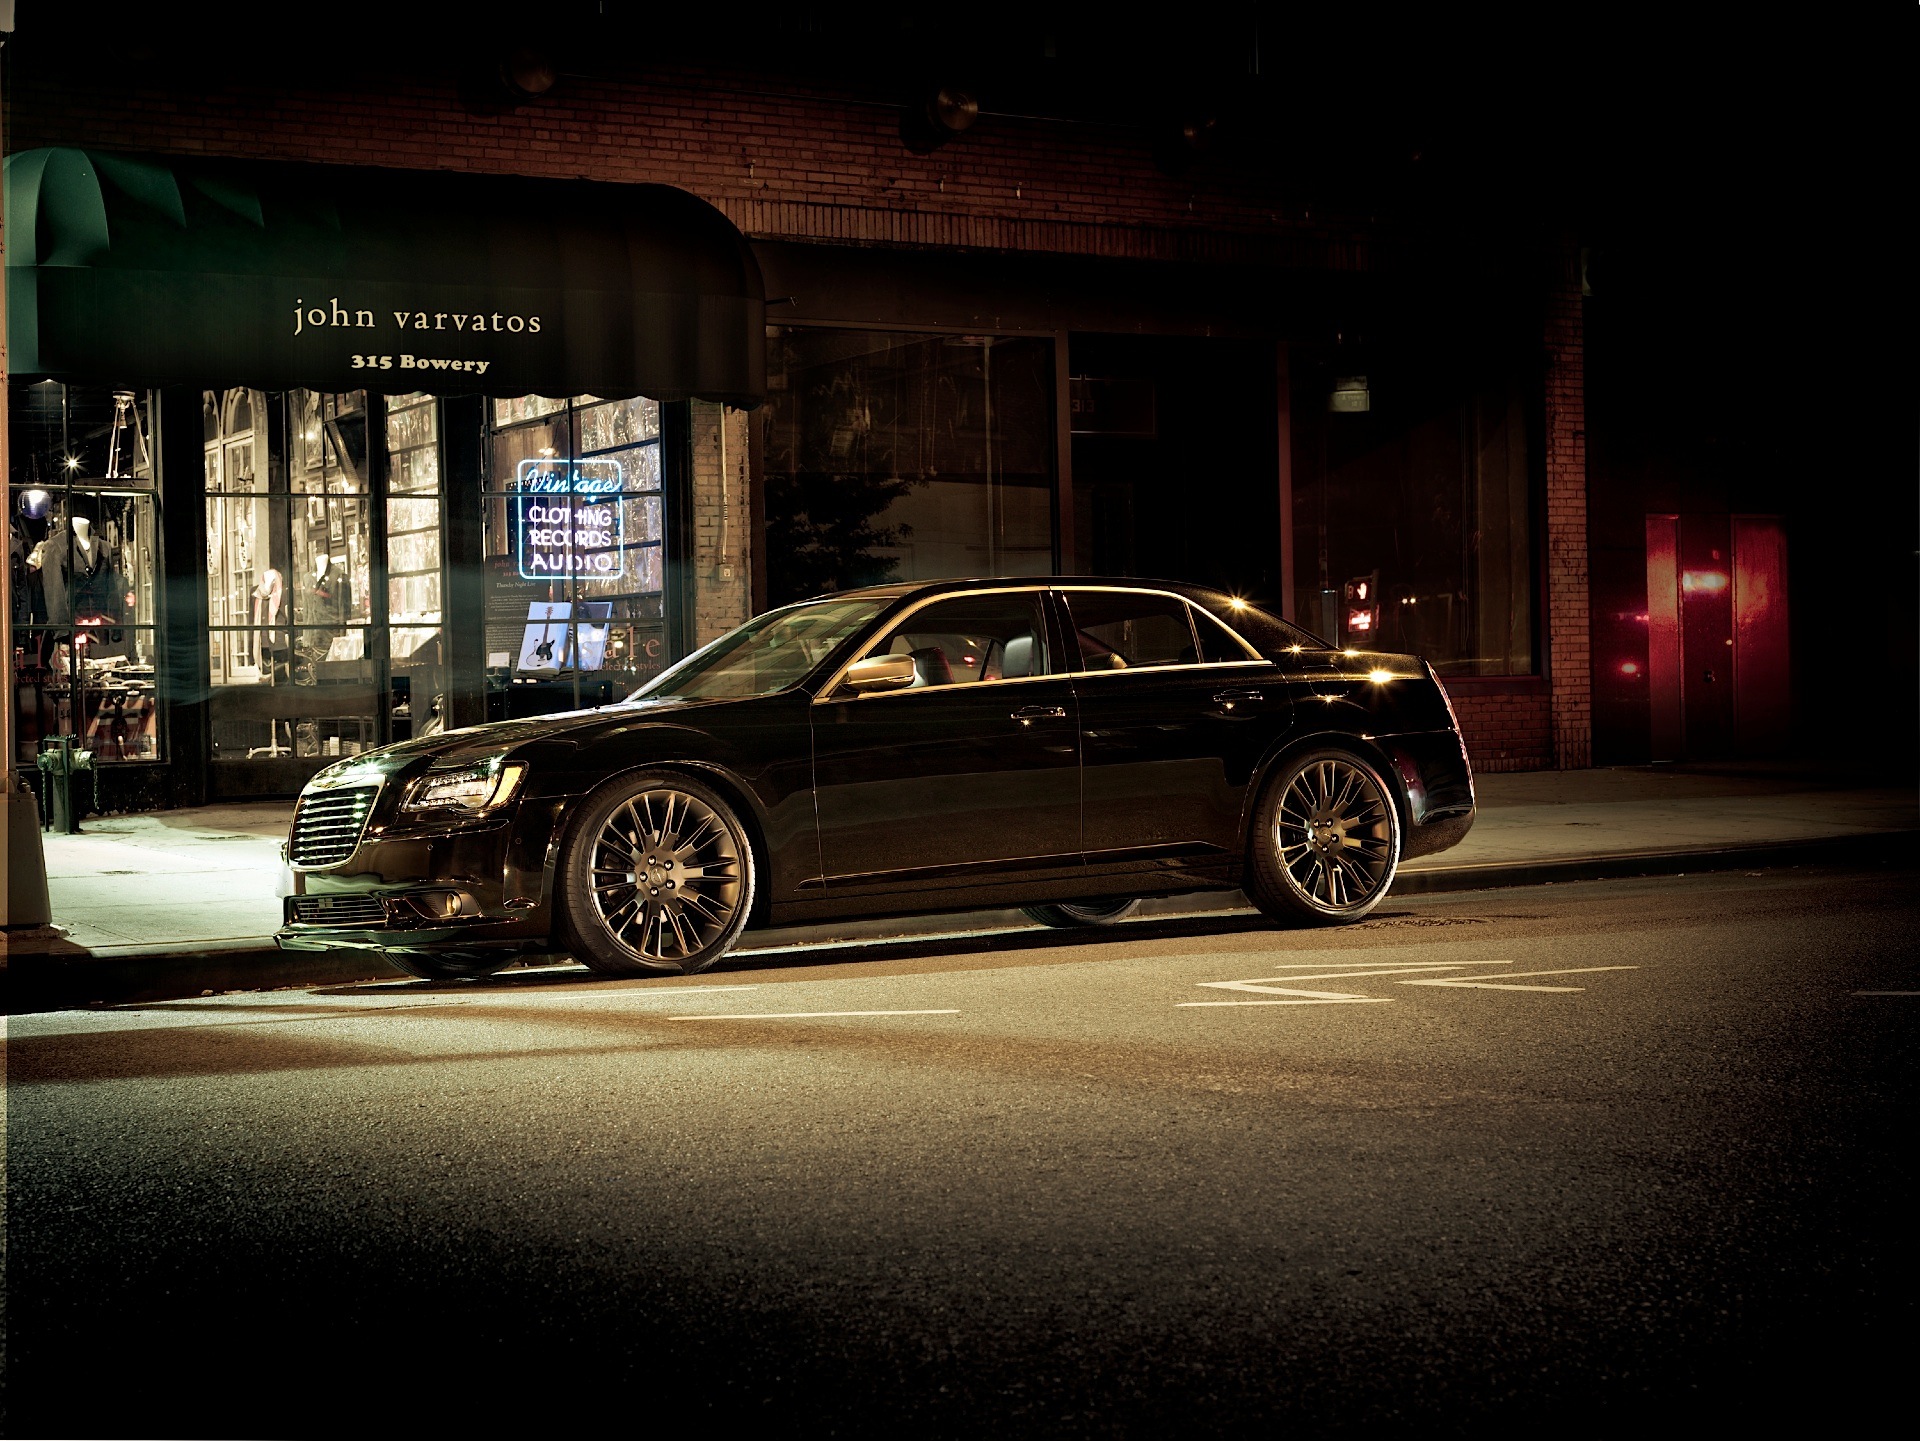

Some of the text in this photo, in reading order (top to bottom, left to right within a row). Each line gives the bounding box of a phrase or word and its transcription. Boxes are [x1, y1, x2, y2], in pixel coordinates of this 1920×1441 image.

[293, 297, 541, 336] john varvatos
[351, 354, 490, 374] 315 Bowery
[529, 530, 612, 547] RECORDS
[530, 553, 613, 571] AUDIO
